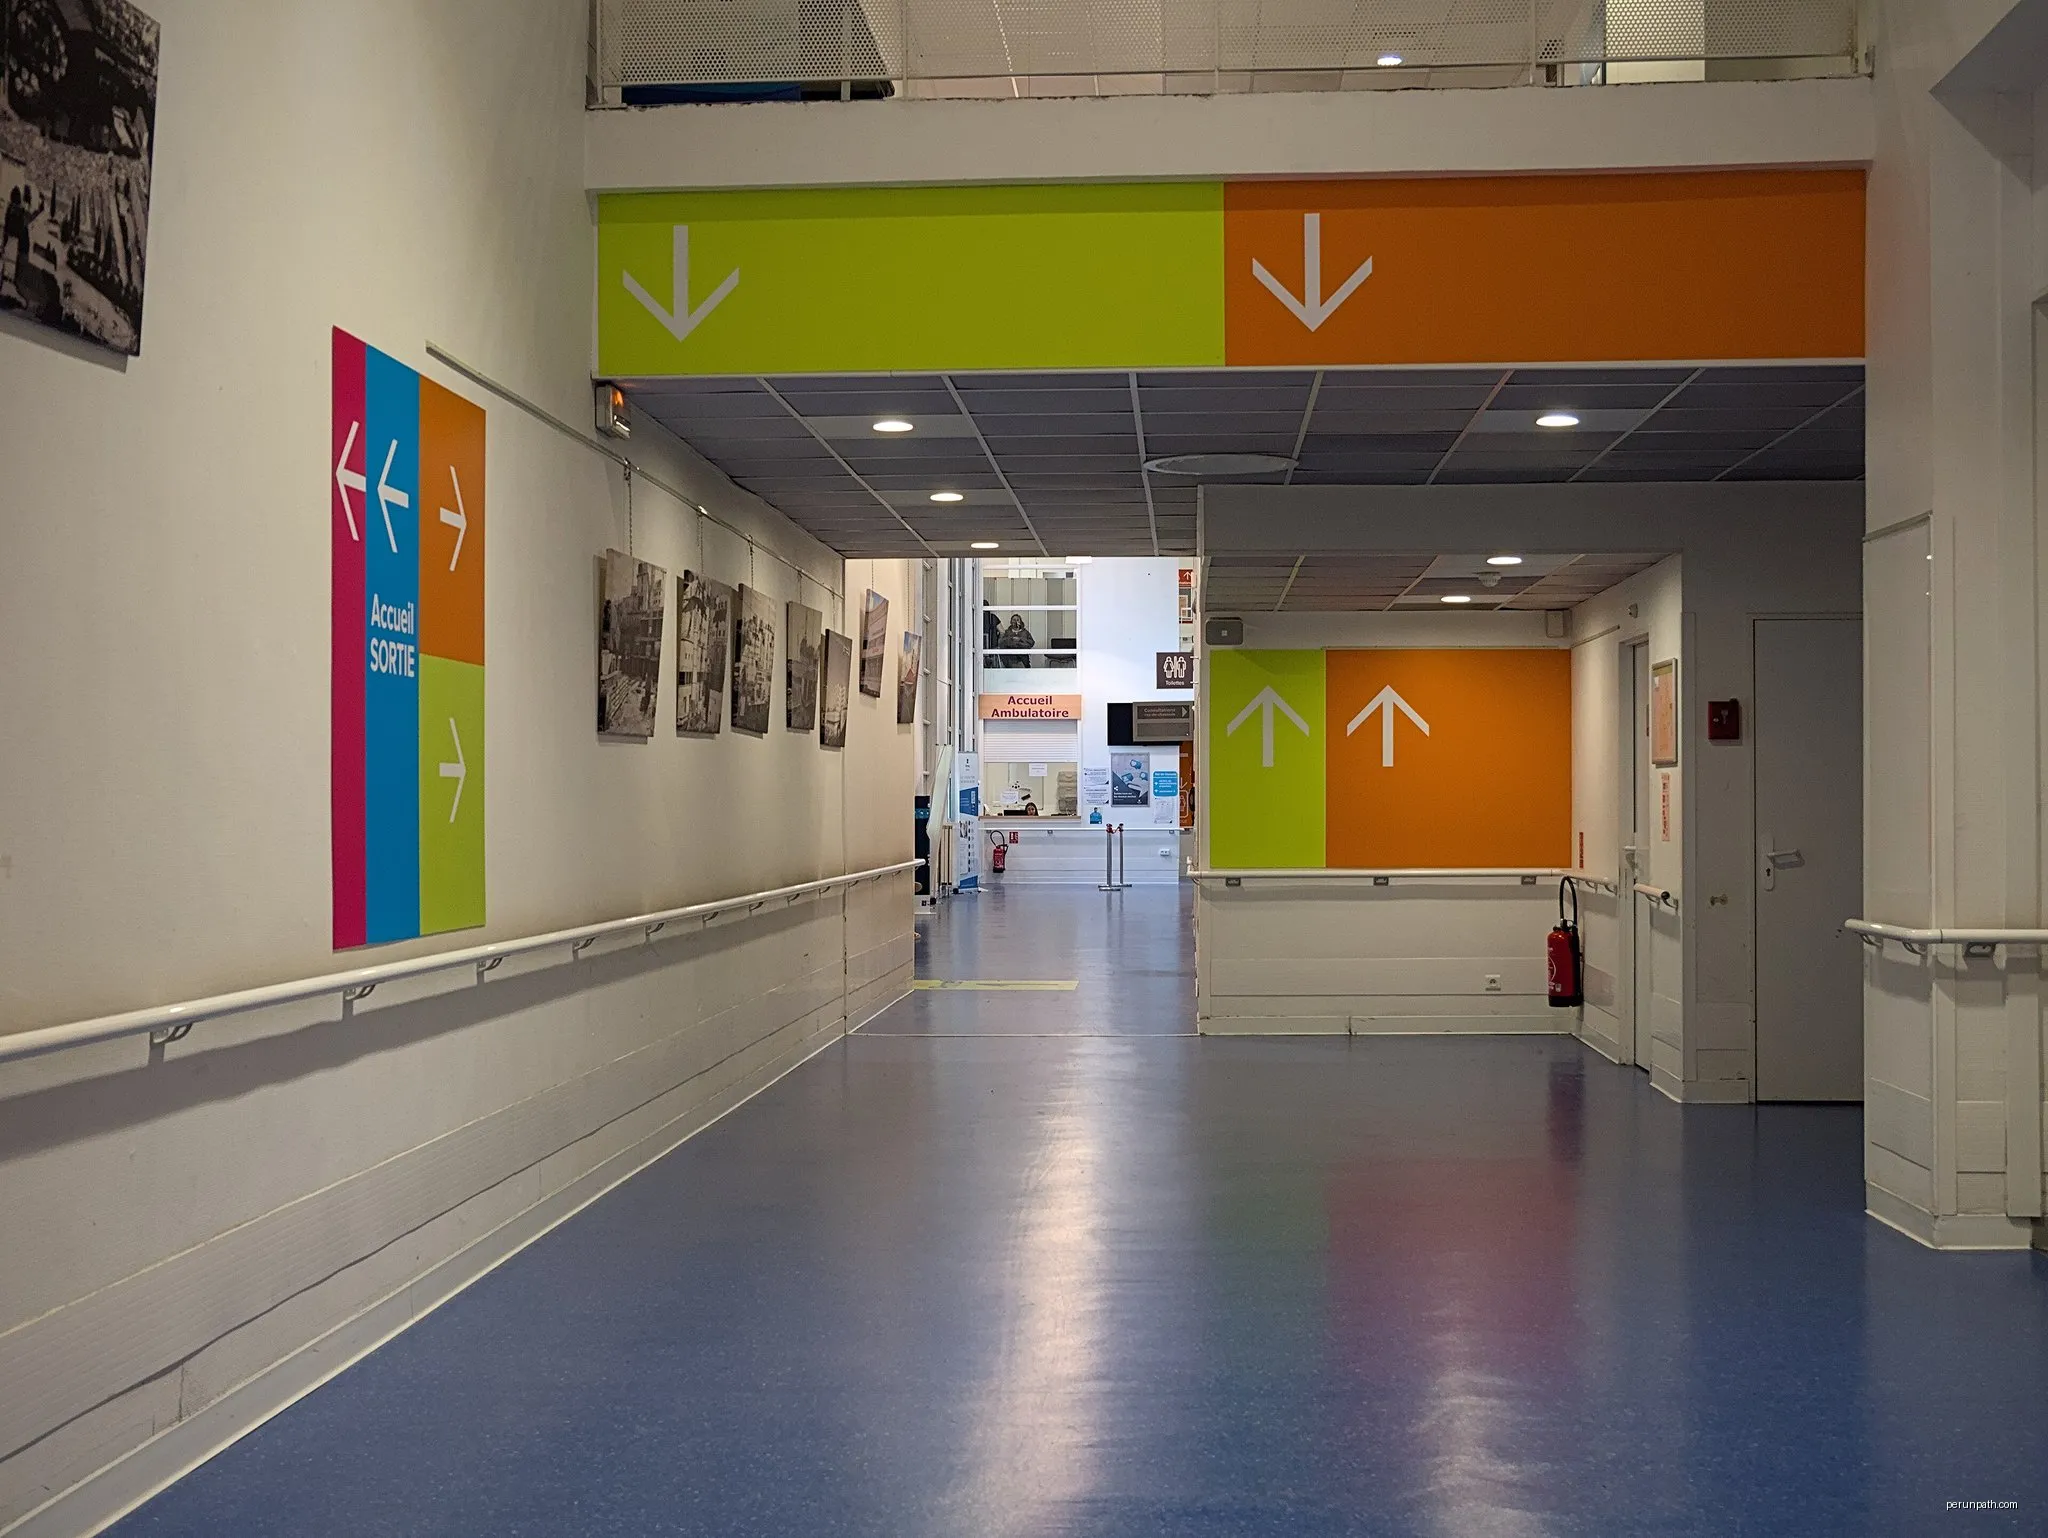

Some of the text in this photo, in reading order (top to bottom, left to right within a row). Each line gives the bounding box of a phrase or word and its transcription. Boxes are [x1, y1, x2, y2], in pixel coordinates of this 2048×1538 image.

[370, 593, 415, 635] Accueil
[370, 637, 415, 678] SORTIE
[1007, 695, 1053, 705] Accueil
[991, 708, 1069, 718] Ambulatoire
